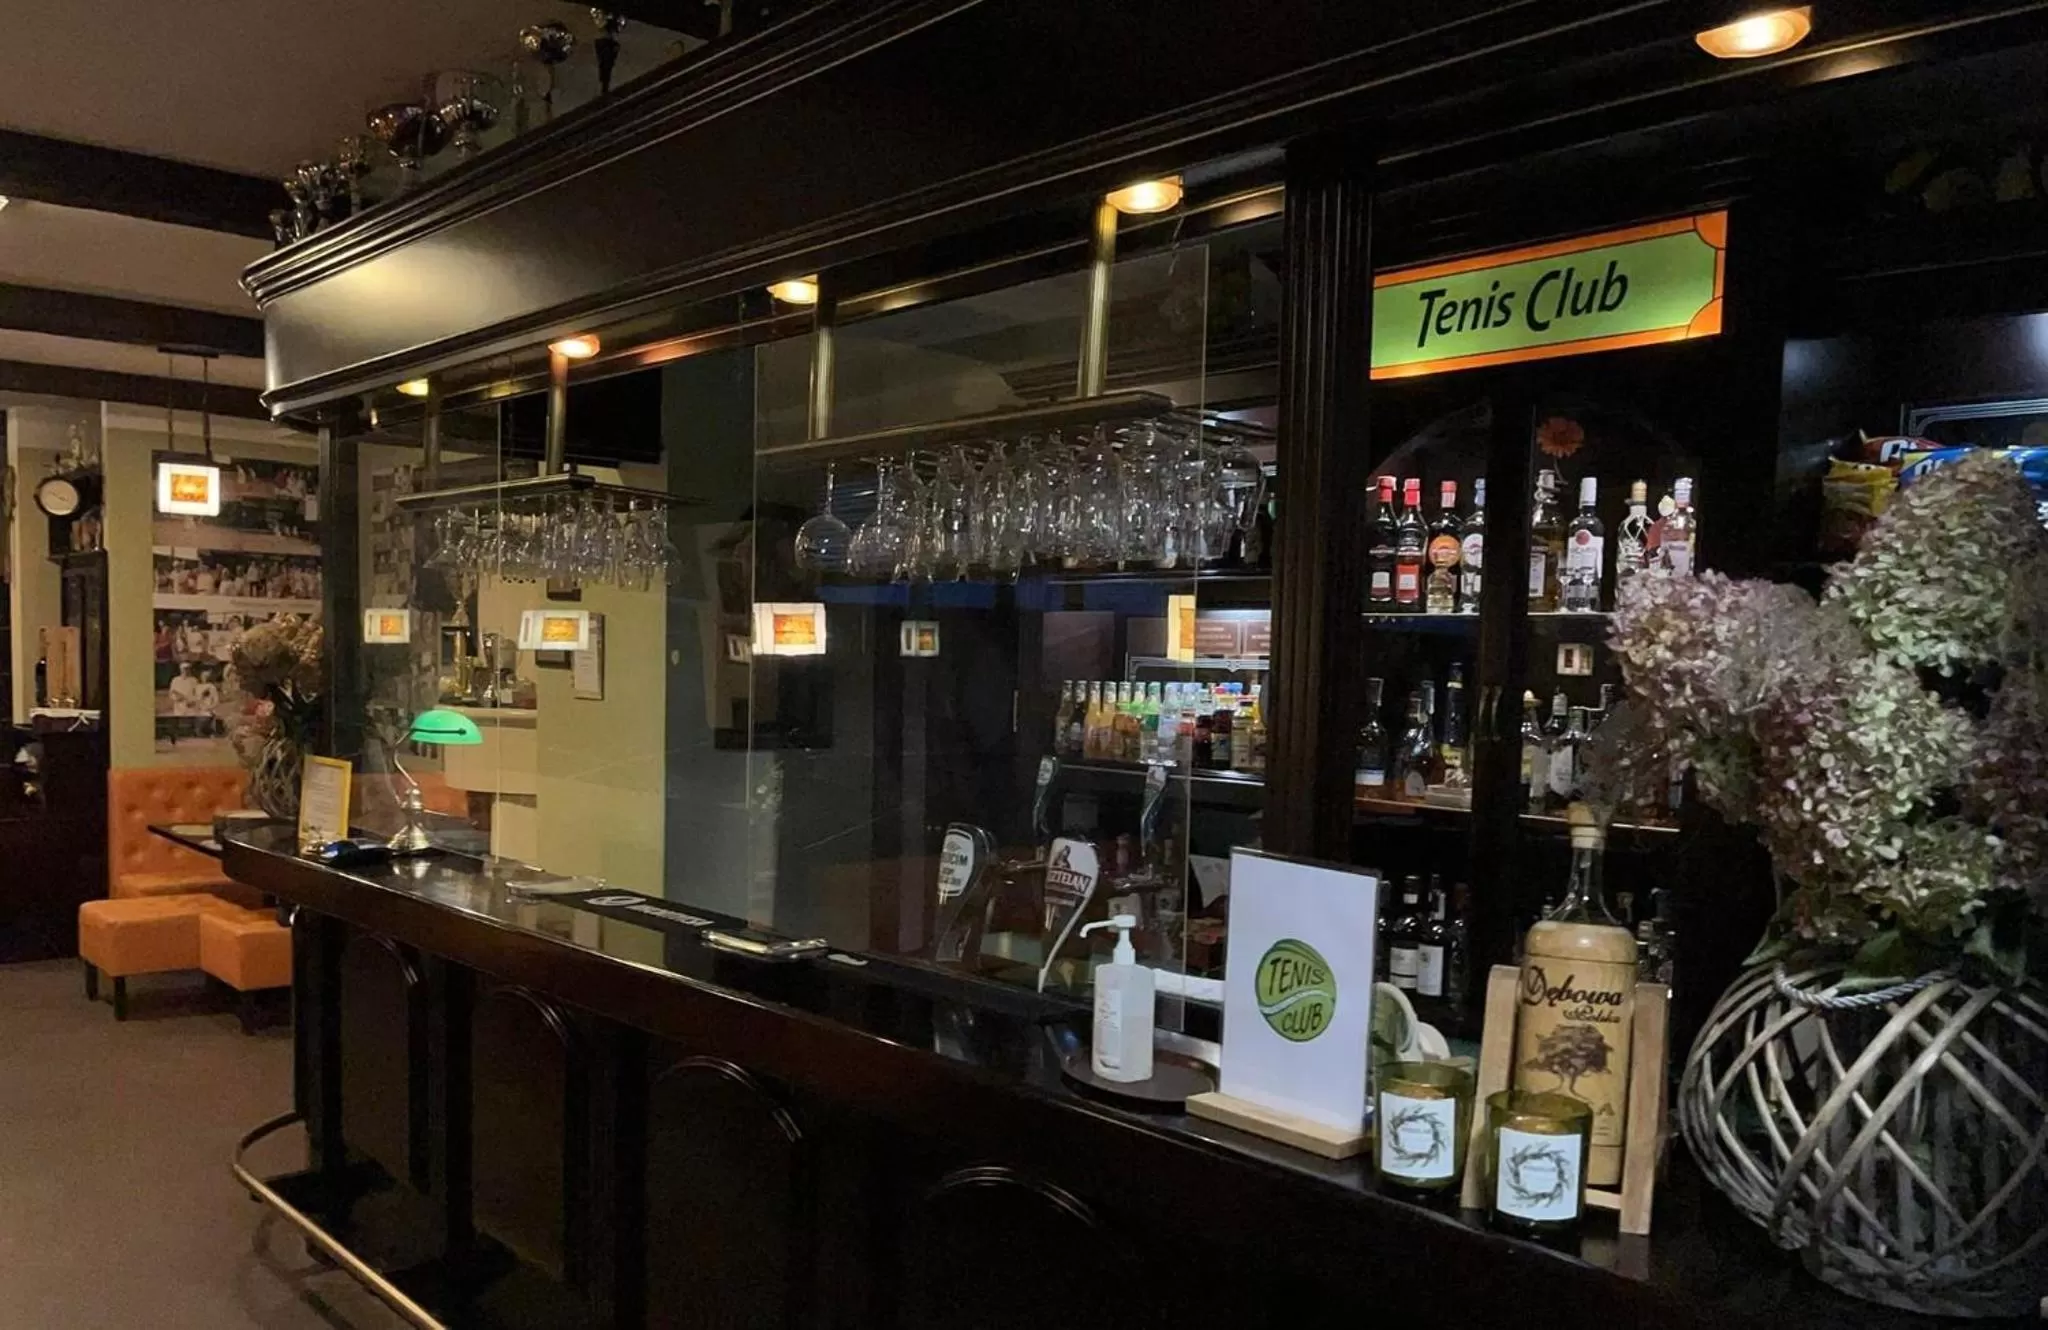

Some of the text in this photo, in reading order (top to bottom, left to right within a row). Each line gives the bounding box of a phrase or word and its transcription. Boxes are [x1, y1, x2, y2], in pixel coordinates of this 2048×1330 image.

[1417, 260, 1628, 348] Tenis Club
[1269, 957, 1325, 996] TENIS
[1521, 965, 1623, 1007] Dębowa
[1281, 1003, 1323, 1034] CLUB
